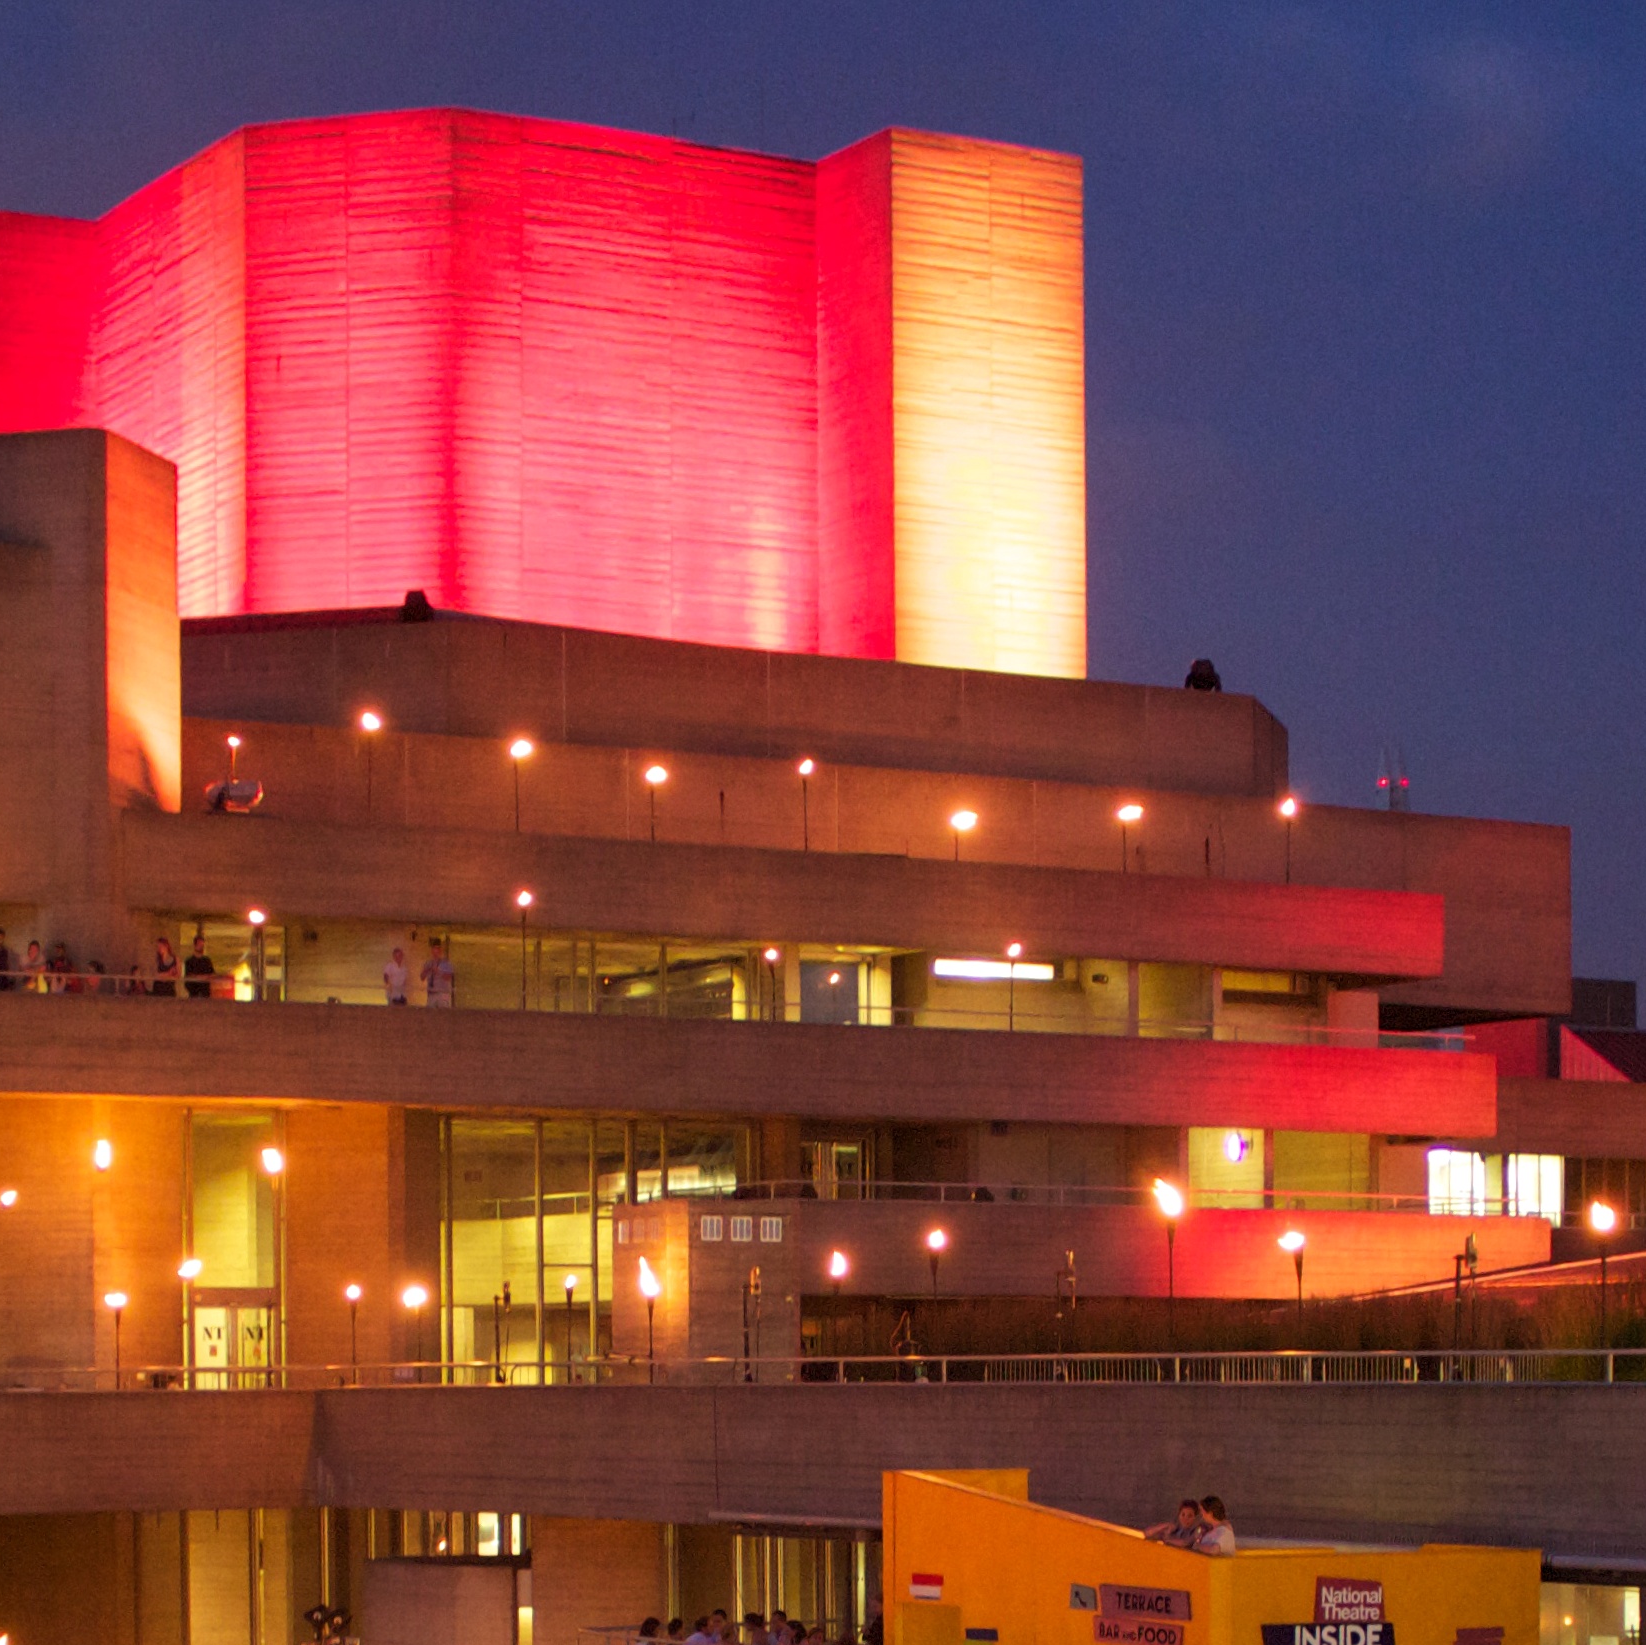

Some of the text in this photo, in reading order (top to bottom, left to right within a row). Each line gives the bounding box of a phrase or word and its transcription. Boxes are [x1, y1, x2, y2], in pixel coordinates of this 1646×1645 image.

[1116, 1592, 1172, 1614] TERRACE
[1321, 1586, 1382, 1605] National
[1322, 1603, 1380, 1621] Theatre
[1099, 1621, 1120, 1639] BAR
[1138, 1626, 1177, 1645] FOOD
